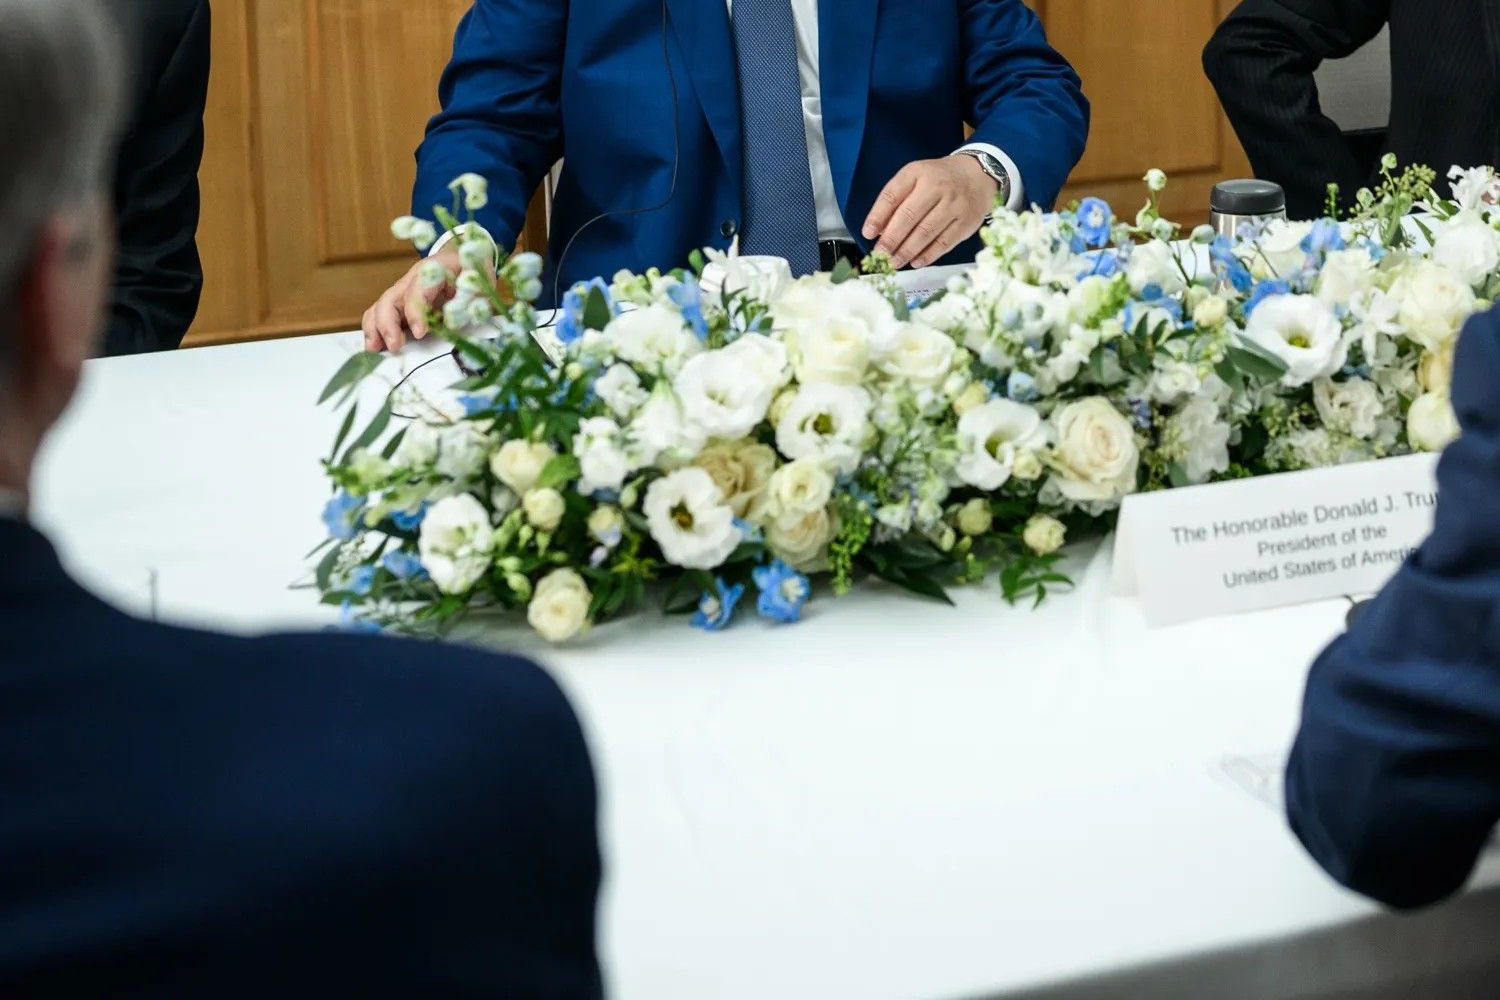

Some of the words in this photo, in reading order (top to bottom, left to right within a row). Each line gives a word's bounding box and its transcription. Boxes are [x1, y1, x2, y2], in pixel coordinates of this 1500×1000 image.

[1171, 526, 1207, 545] The
[1214, 509, 1308, 537] Honorable
[1314, 499, 1378, 524] Donald
[1384, 495, 1398, 512] J.
[1404, 491, 1439, 509] Tru
[1257, 531, 1336, 557] President
[1342, 528, 1357, 544] of
[1362, 524, 1387, 542] the
[1223, 563, 1278, 588] United
[1282, 555, 1336, 579] States
[1342, 551, 1357, 569] of
